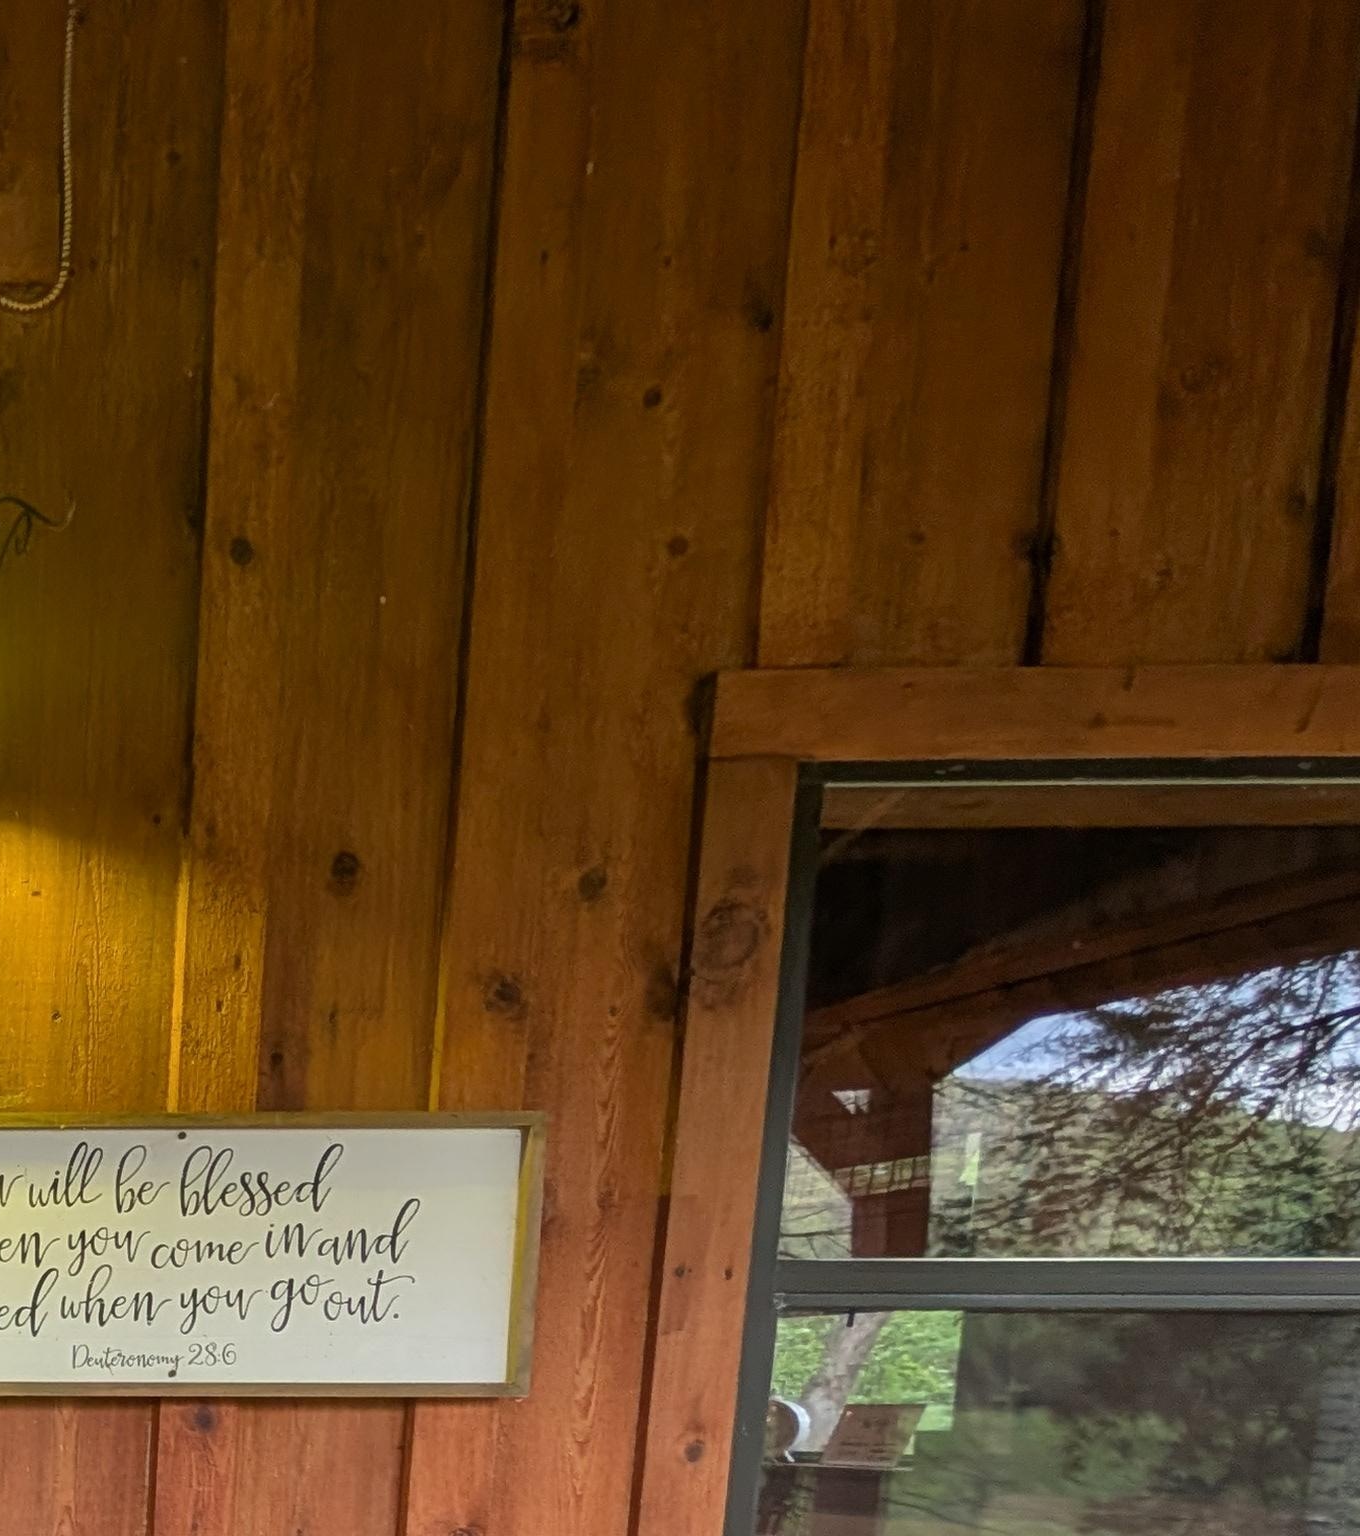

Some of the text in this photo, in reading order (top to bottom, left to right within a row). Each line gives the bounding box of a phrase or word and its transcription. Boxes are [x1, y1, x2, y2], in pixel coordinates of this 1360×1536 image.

[29, 1141, 104, 1208] will
[115, 1144, 172, 1214] be
[179, 1142, 345, 1217] blessed
[67, 1226, 152, 1277] you
[151, 1238, 260, 1269] come
[264, 1222, 324, 1259] in
[317, 1197, 421, 1266] and
[59, 1263, 173, 1327] when
[179, 1285, 264, 1335] you
[269, 1273, 336, 1333] go
[323, 1268, 416, 1325] out.
[71, 1342, 238, 1375] Deuteronomy 28:6
